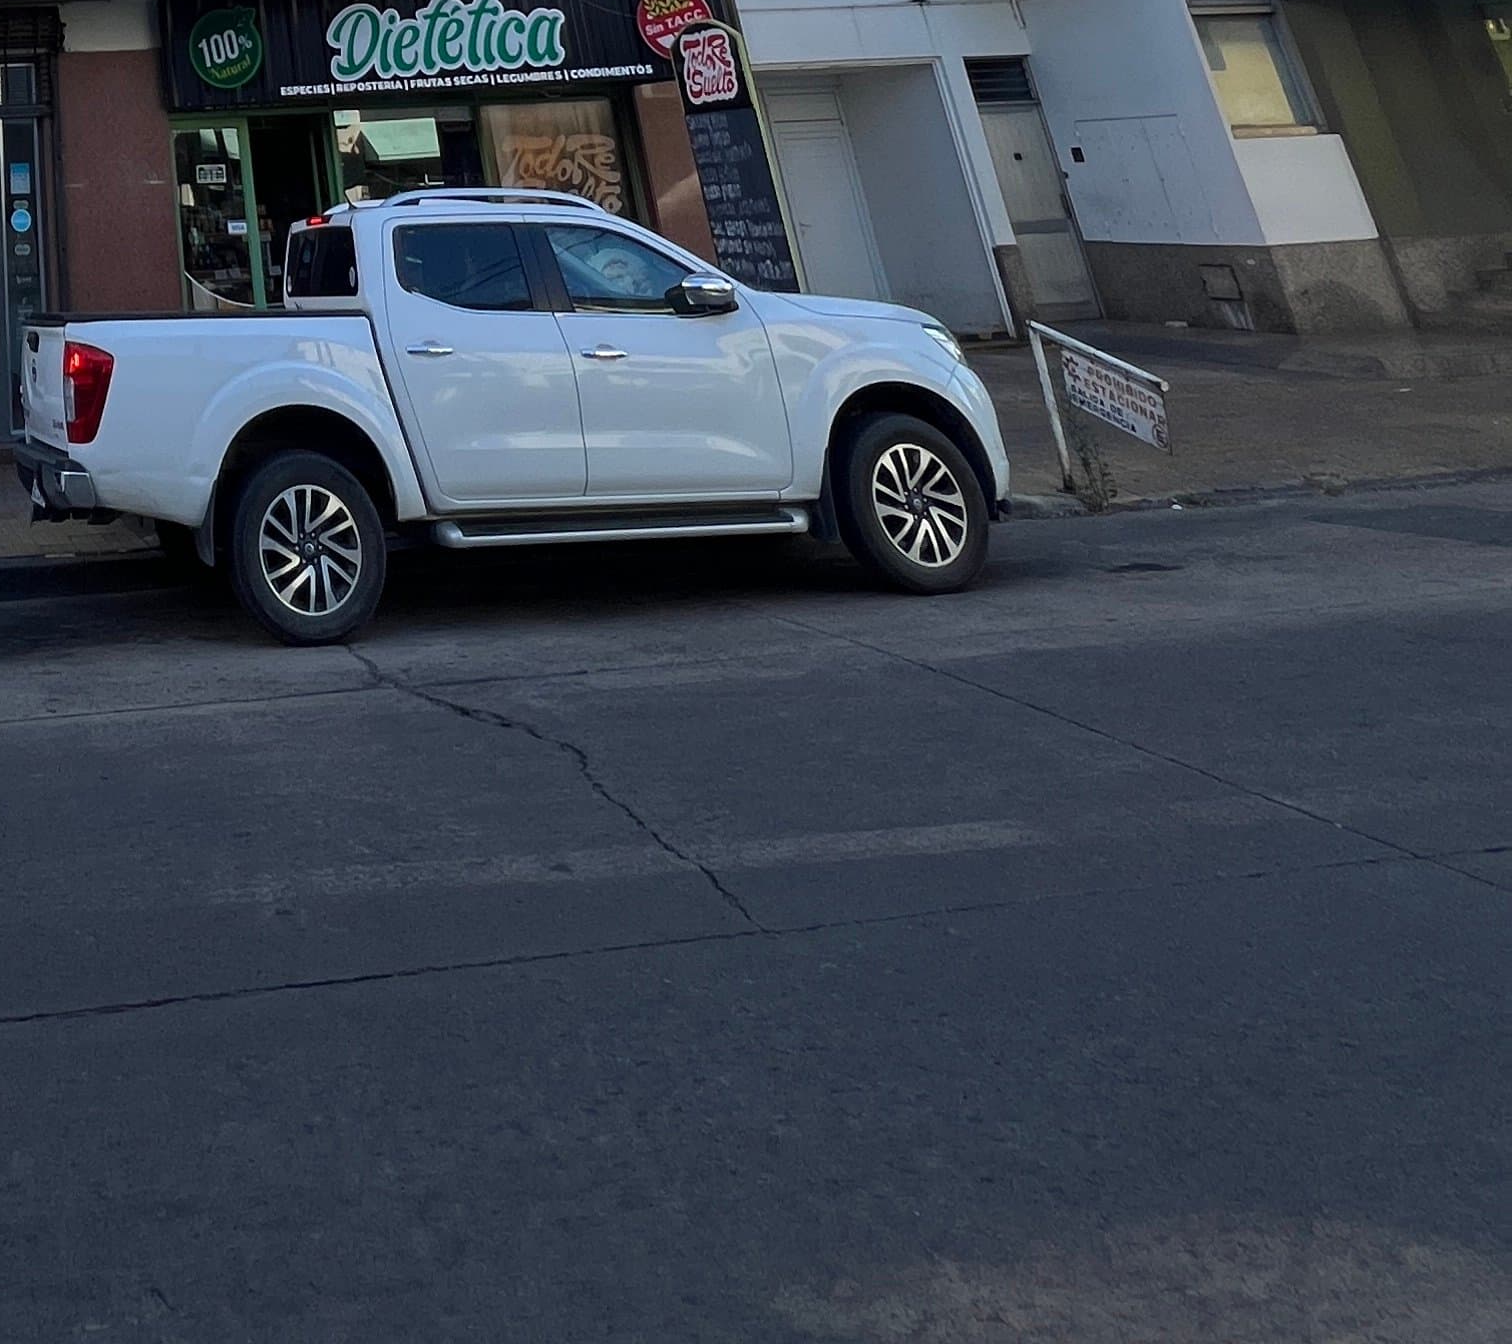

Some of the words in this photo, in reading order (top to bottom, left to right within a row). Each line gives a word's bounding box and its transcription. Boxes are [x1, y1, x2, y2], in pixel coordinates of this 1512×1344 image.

[645, 23, 664, 36] Sin
[197, 29, 253, 68] 100%
[707, 34, 731, 68] Re
[208, 53, 251, 80] Natural
[280, 84, 330, 97] ESPECIES
[336, 79, 403, 93] REPOSTERIA
[410, 76, 451, 89] FRUTAS
[454, 73, 488, 86] SECAS
[496, 69, 562, 84] LEGUMBRES
[689, 67, 735, 99] Suelto
[502, 134, 574, 188] Todo
[566, 134, 621, 184] Re
[1071, 384, 1104, 407] SALIDA
[1109, 404, 1124, 417] DE
[1083, 378, 1166, 425] ESTACIONAR
[1087, 365, 1156, 408] PROHIBIDO
[1071, 393, 1137, 433] EMERGENCIA
